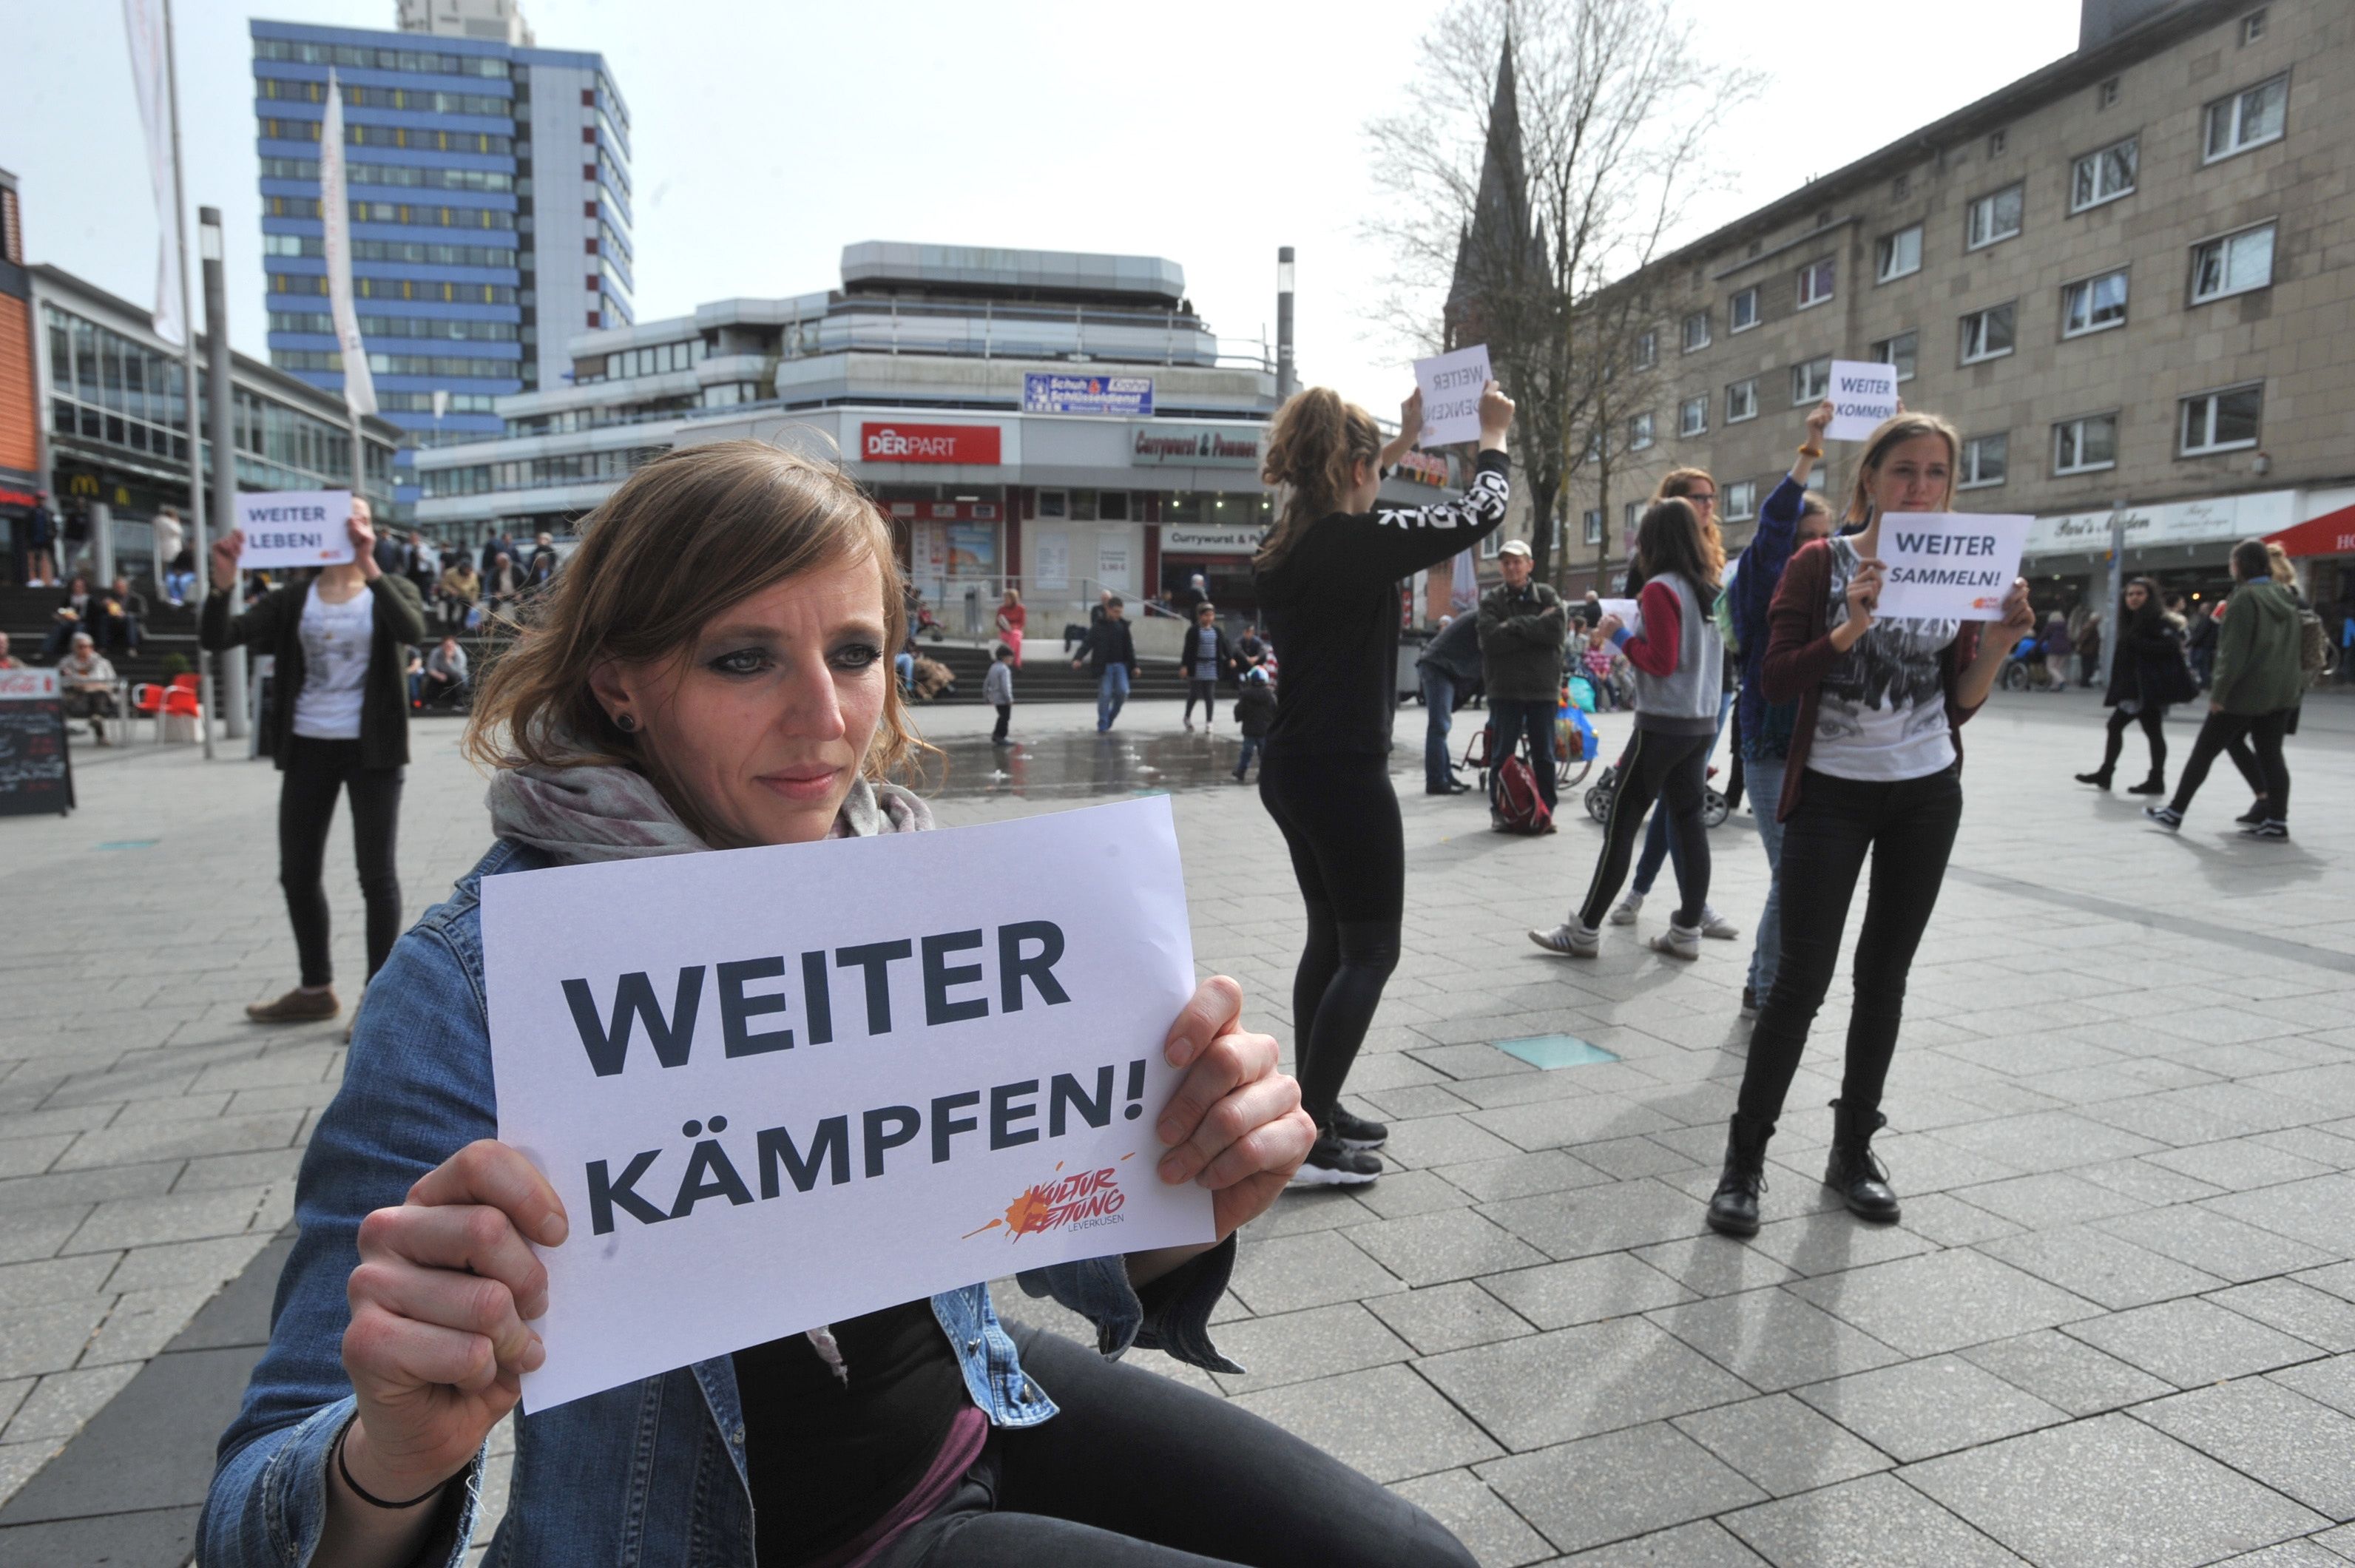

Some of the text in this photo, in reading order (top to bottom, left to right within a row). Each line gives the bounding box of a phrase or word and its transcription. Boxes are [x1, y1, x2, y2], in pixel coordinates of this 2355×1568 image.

[1840, 376, 1891, 394] WEITER
[248, 506, 325, 522] WEITER
[249, 533, 322, 549] LEBEN!
[1172, 532, 1234, 545] Currywurst
[1896, 533, 1996, 556] WEITER
[1889, 567, 2001, 587] SAMMELN!
[561, 919, 1071, 1077] WEITER
[585, 1058, 1147, 1235] KÄMPFEN!
[1024, 1168, 1118, 1215] KULTUR
[1013, 1189, 1125, 1244] RETTUNG
[1068, 1214, 1125, 1233] LEVERKUSEN
